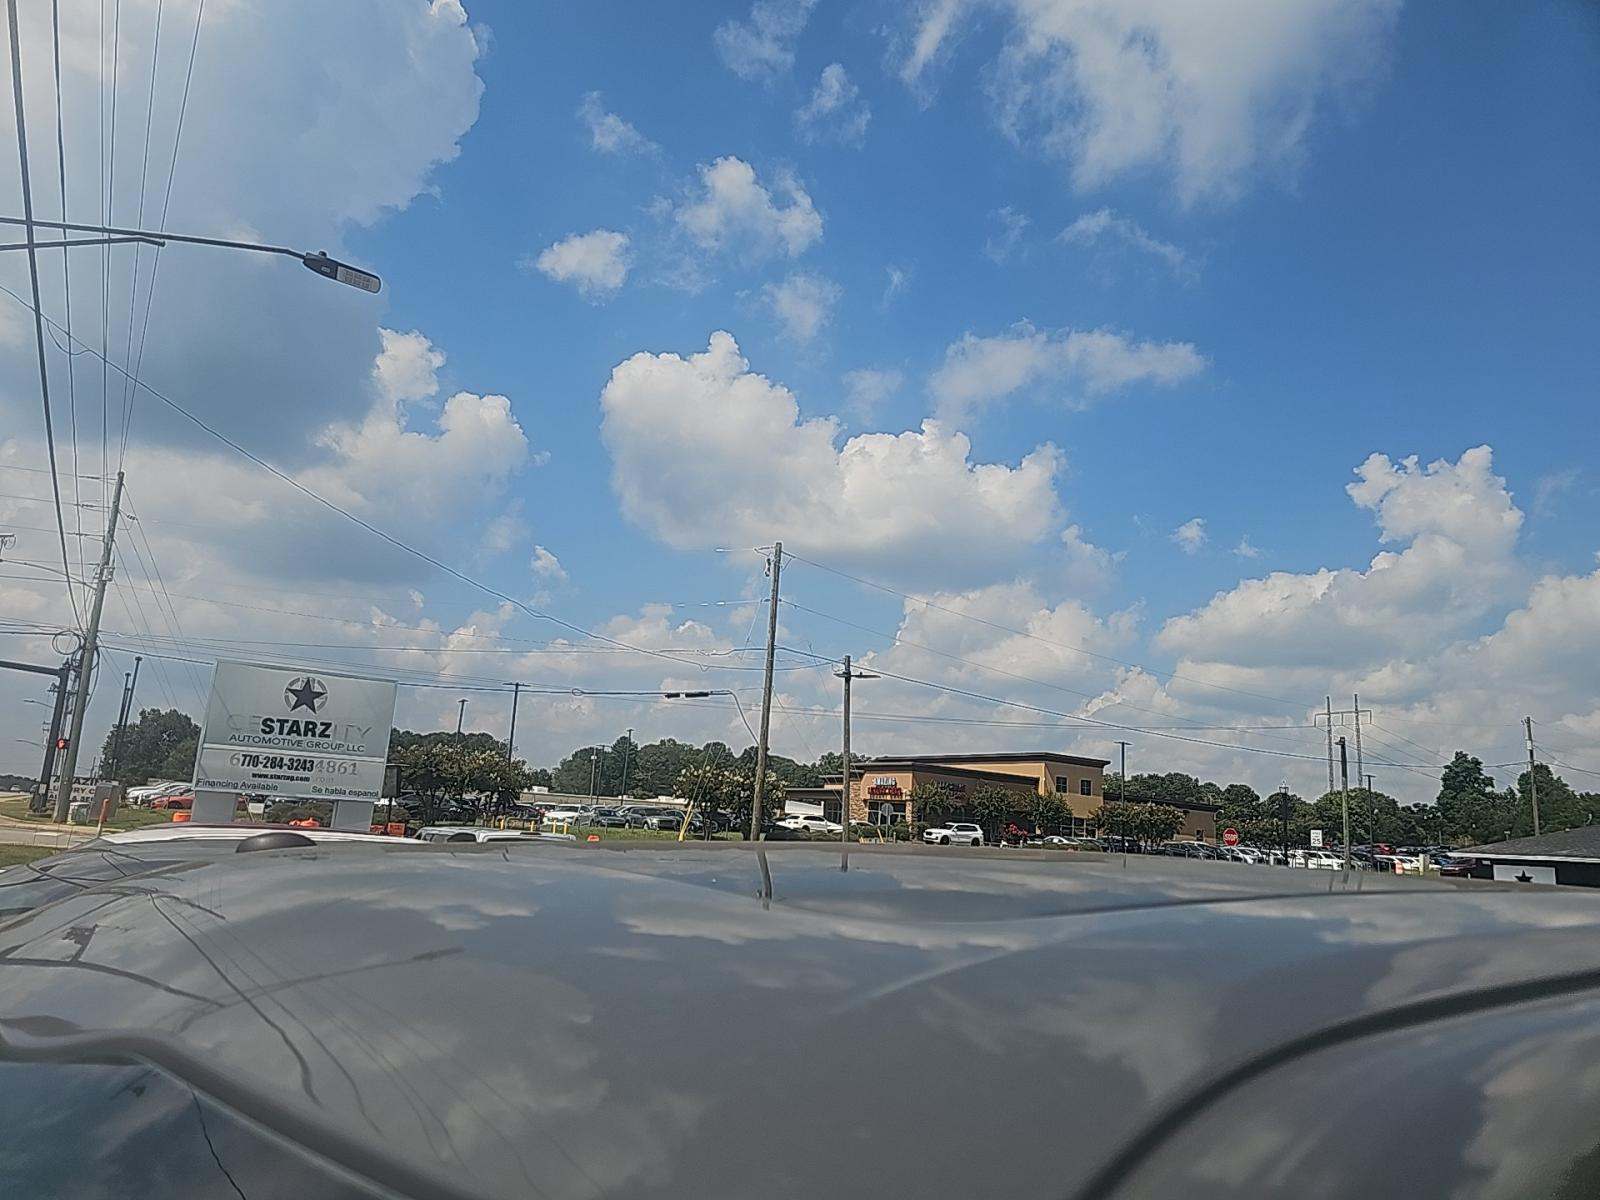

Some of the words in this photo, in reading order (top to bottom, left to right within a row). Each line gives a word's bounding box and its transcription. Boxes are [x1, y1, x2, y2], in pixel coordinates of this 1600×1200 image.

[260, 717, 333, 739] STARZ
[229, 734, 304, 748] AUTOMOTIVE
[306, 740, 344, 751] GROUP
[346, 743, 365, 752] LLC
[240, 753, 315, 772] 770-284-3243
[195, 778, 239, 790] Financing
[240, 781, 279, 791] Available
[311, 785, 323, 794] Se
[324, 787, 347, 796] habla
